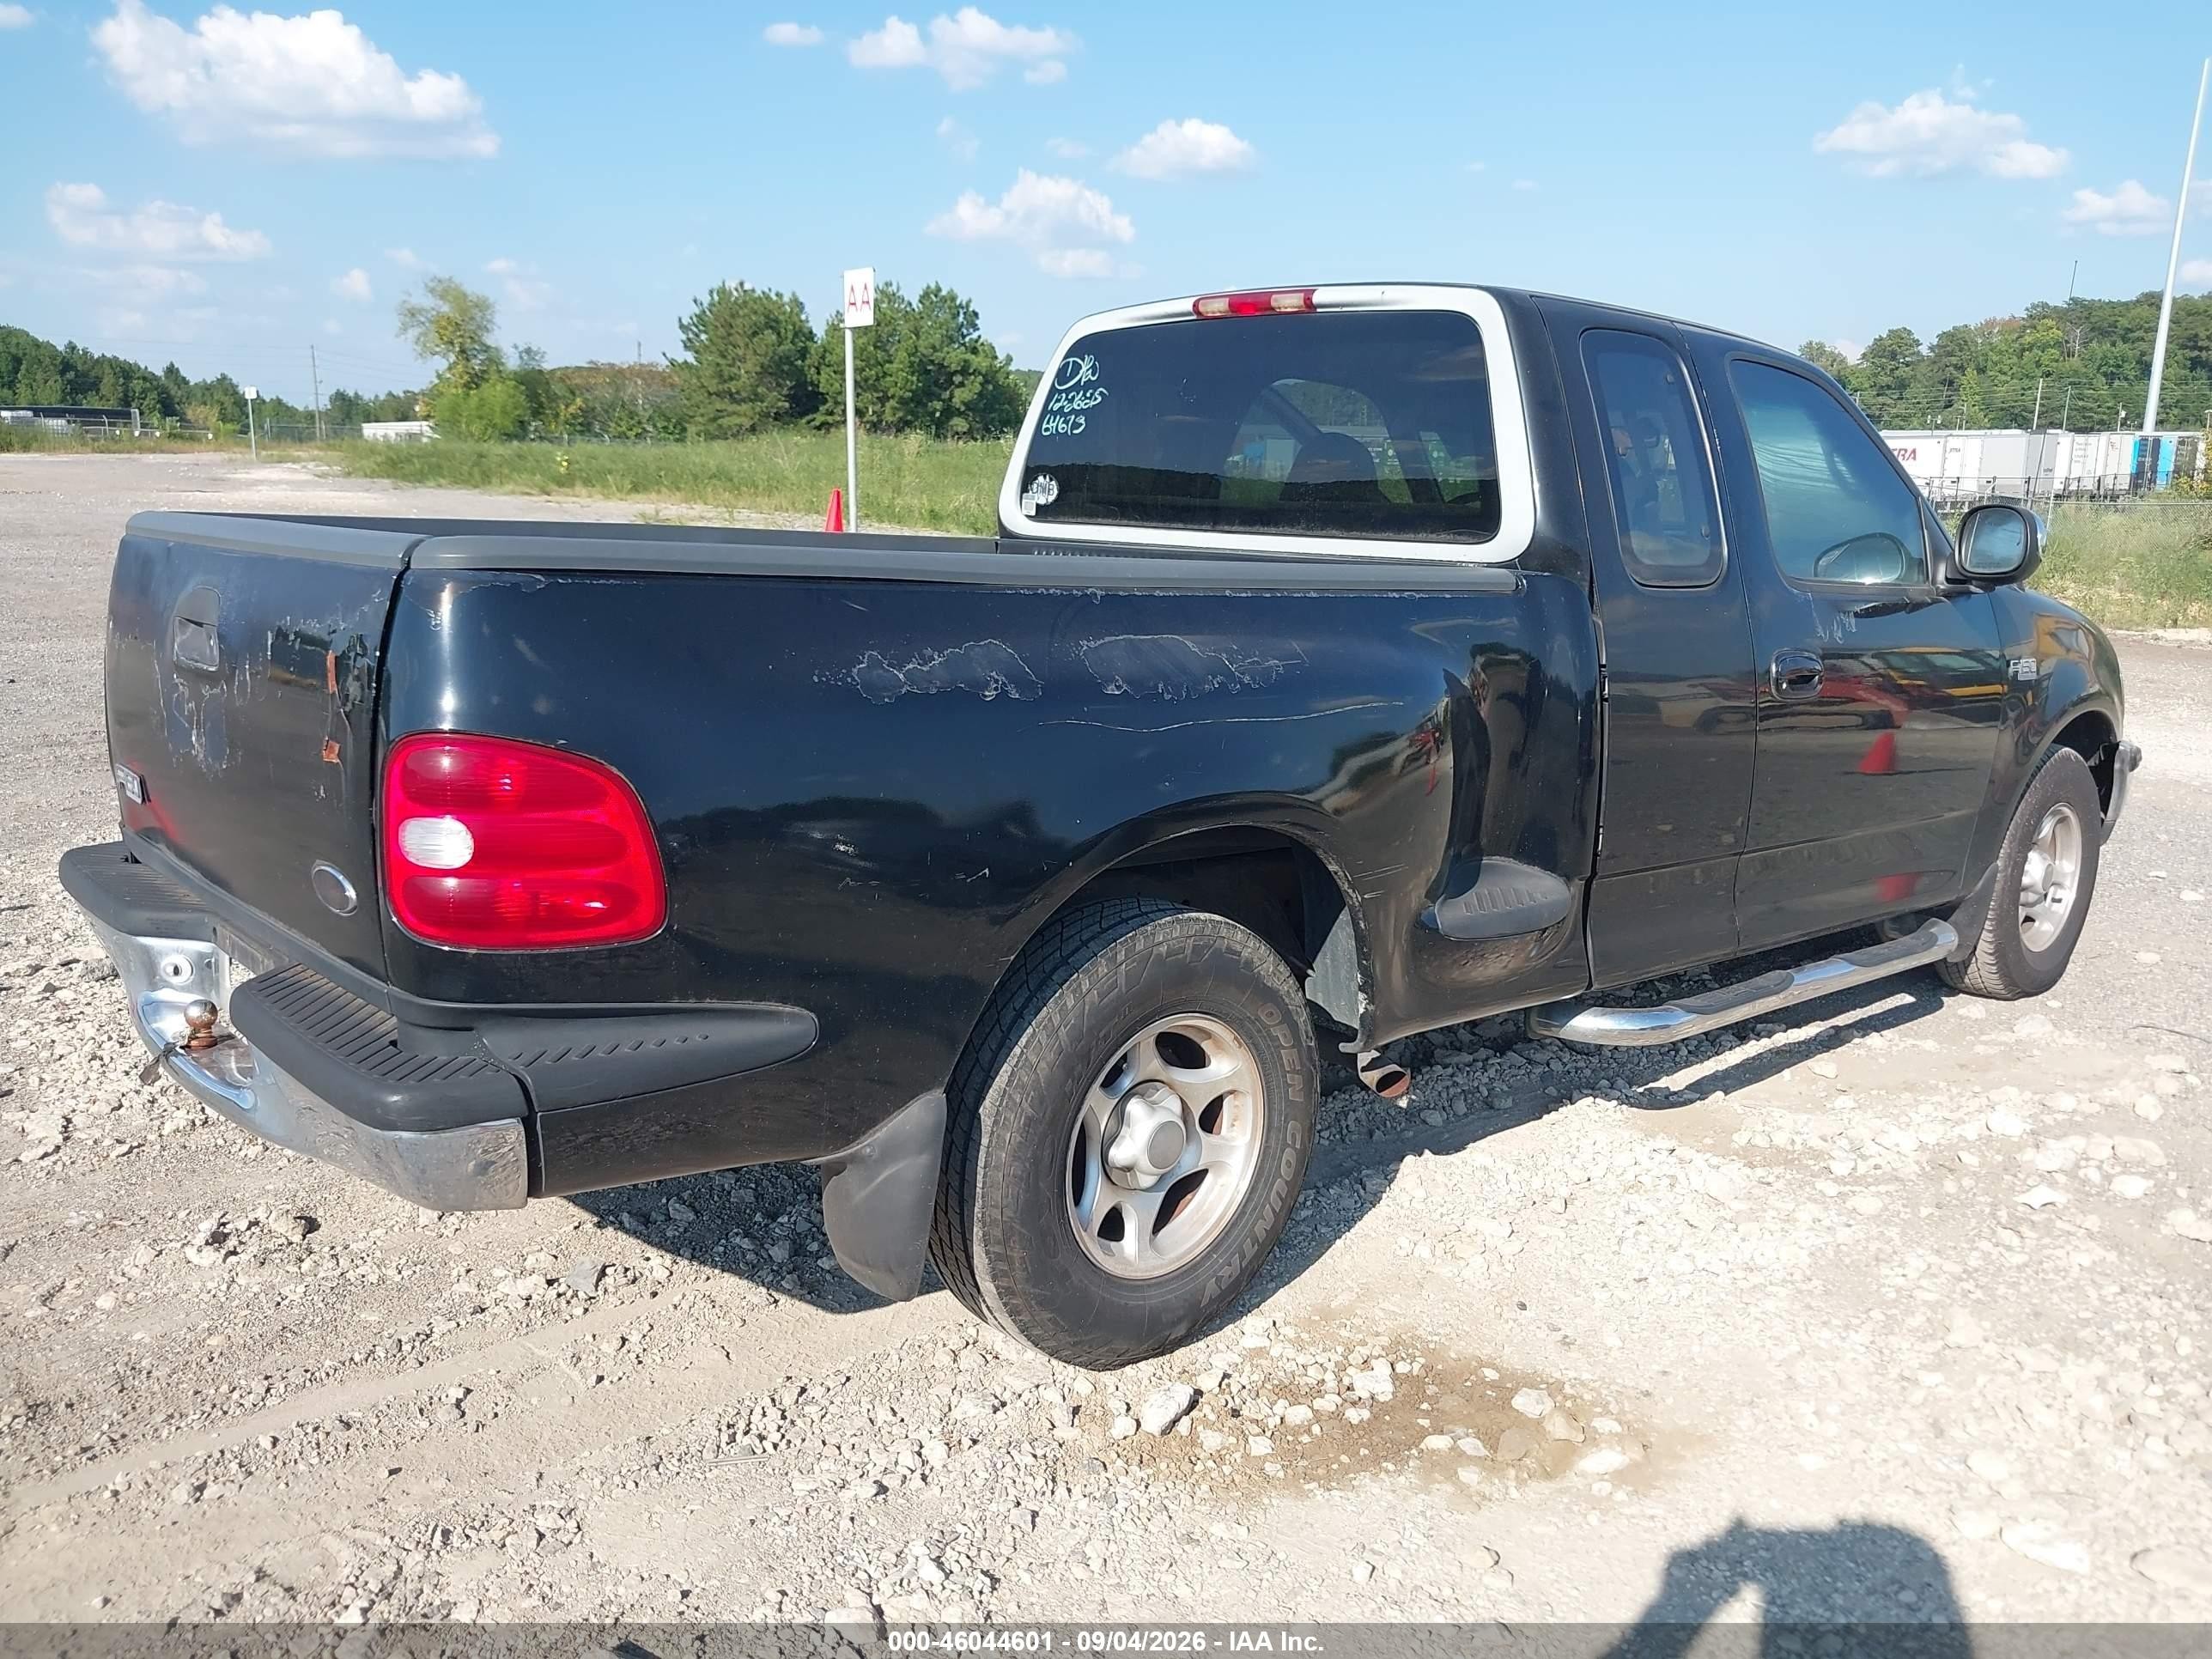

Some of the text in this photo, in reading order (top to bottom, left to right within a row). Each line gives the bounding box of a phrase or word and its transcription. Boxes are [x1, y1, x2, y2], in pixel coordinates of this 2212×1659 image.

[848, 283, 872, 313] AA
[1201, 1003, 1304, 1307] OPEN COUNTRY
